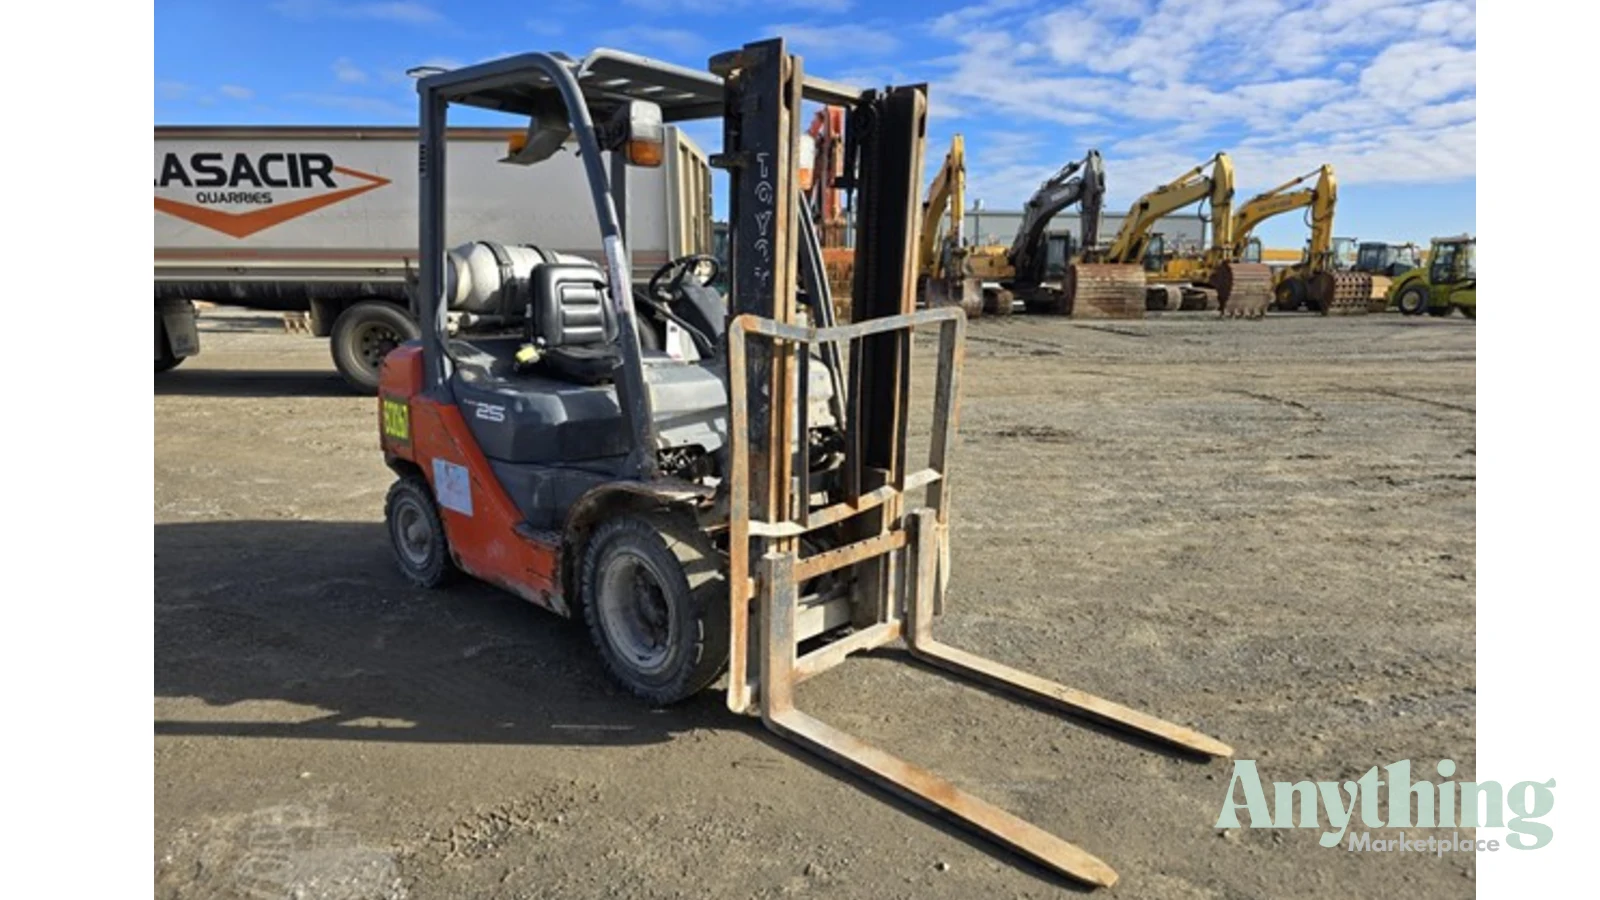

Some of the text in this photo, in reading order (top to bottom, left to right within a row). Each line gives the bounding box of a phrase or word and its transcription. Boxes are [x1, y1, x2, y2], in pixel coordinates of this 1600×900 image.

[154, 153, 337, 188] ASACIR
[196, 191, 273, 204] QUARRIES
[475, 402, 505, 422] 25
